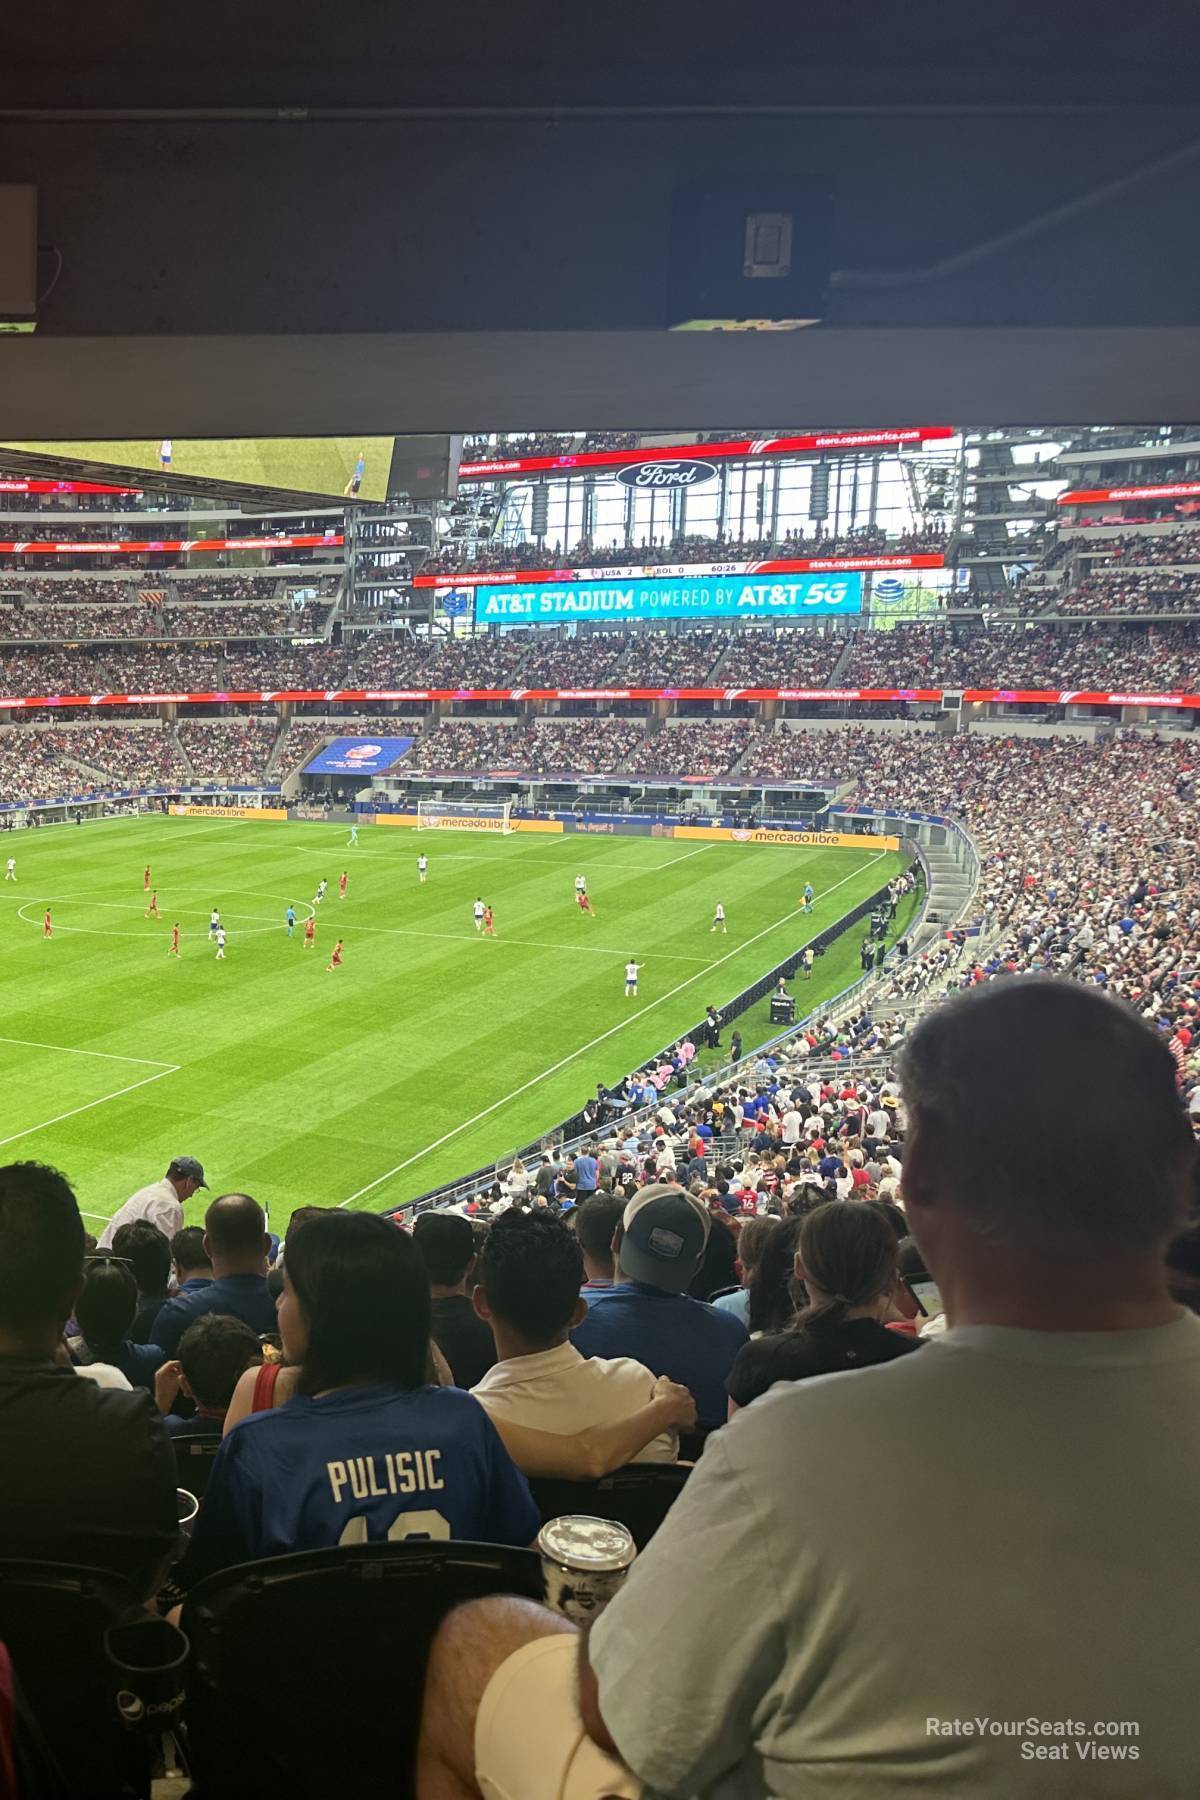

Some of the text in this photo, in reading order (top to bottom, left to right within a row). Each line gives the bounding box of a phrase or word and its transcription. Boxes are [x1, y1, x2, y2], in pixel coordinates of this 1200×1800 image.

[816, 431, 920, 446] store.copaamerica.com
[636, 463, 697, 486] Ford
[809, 558, 912, 570] store.copaamerica.com
[605, 569, 622, 577] USA
[711, 565, 737, 573] 60:26
[485, 582, 848, 614] AT&T STADIUM POWERED BY AT&T 5G
[190, 807, 246, 817] mercado libre
[441, 818, 487, 828] mercado
[755, 832, 840, 845] mercado libre
[622, 1172, 634, 1185] 22
[742, 1198, 754, 1210] 16
[327, 1449, 445, 1503] PULISIC
